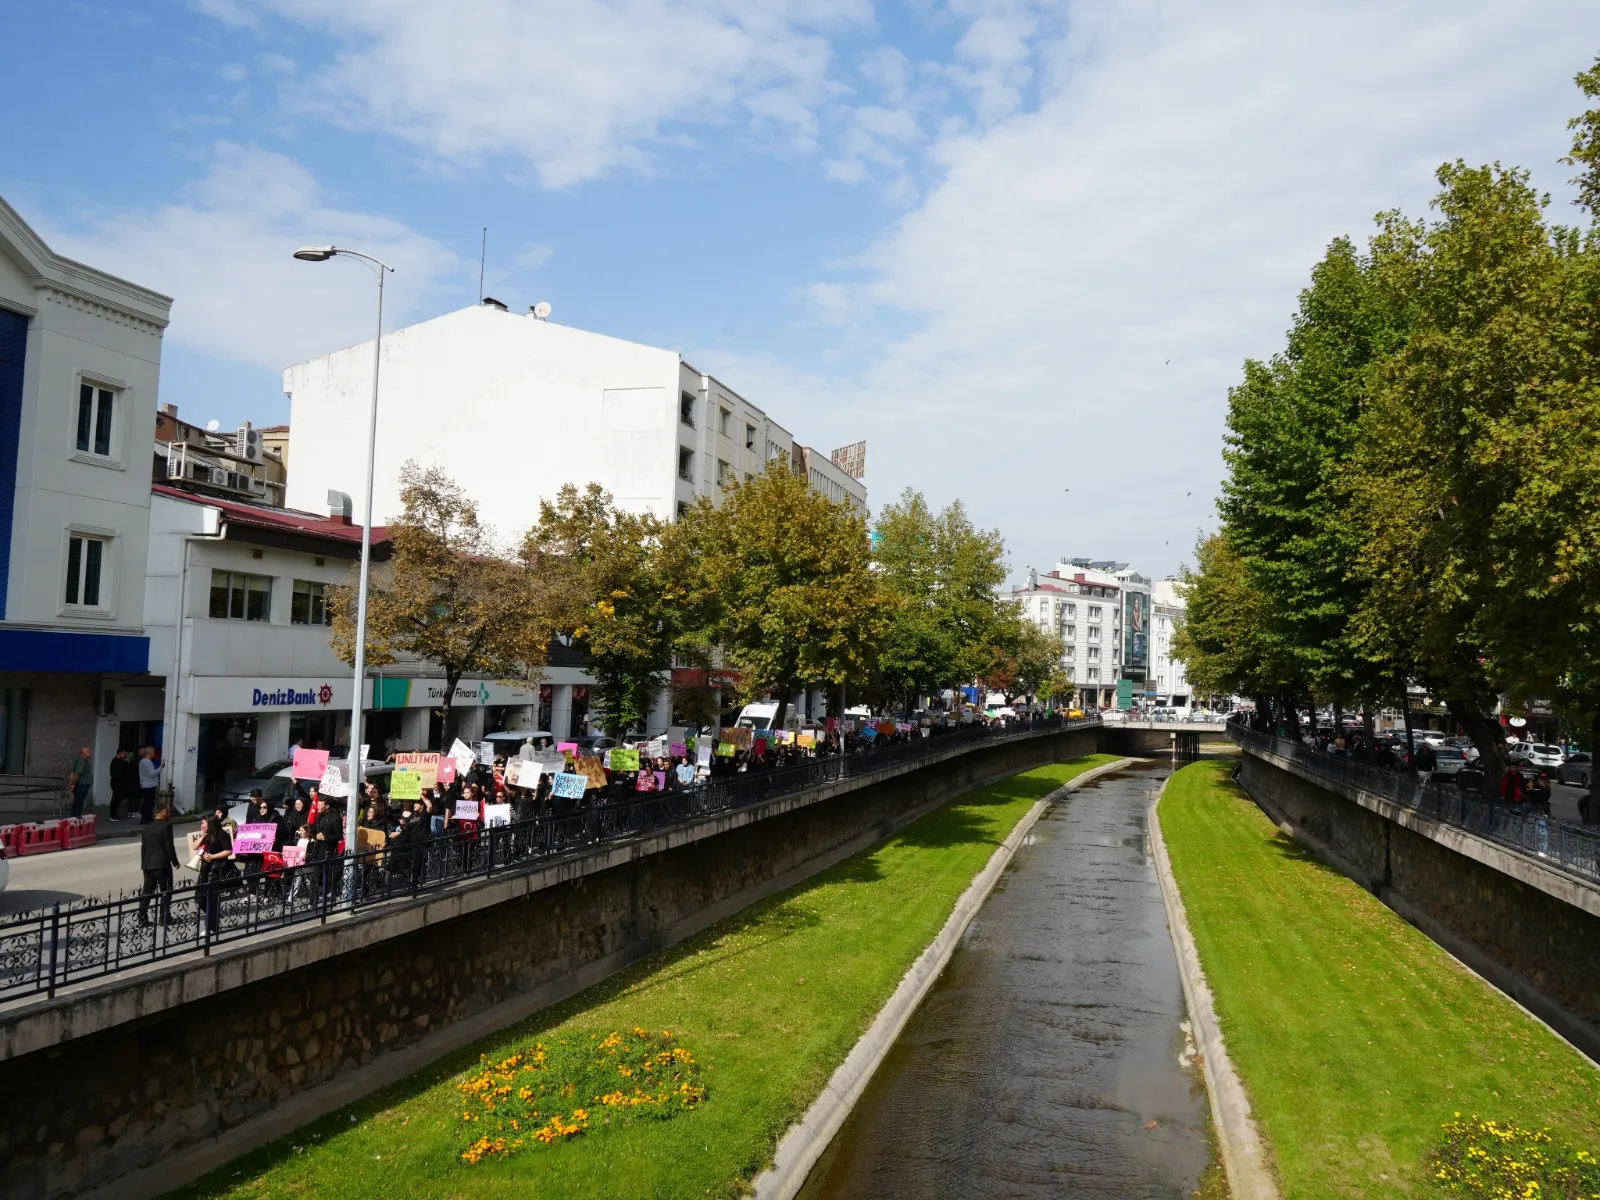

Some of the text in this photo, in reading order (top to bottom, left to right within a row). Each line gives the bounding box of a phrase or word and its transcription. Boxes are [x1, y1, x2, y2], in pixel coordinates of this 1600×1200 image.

[252, 688, 316, 706] DenizBank
[455, 687, 477, 698] Finans
[397, 754, 438, 765] UNUTMA
